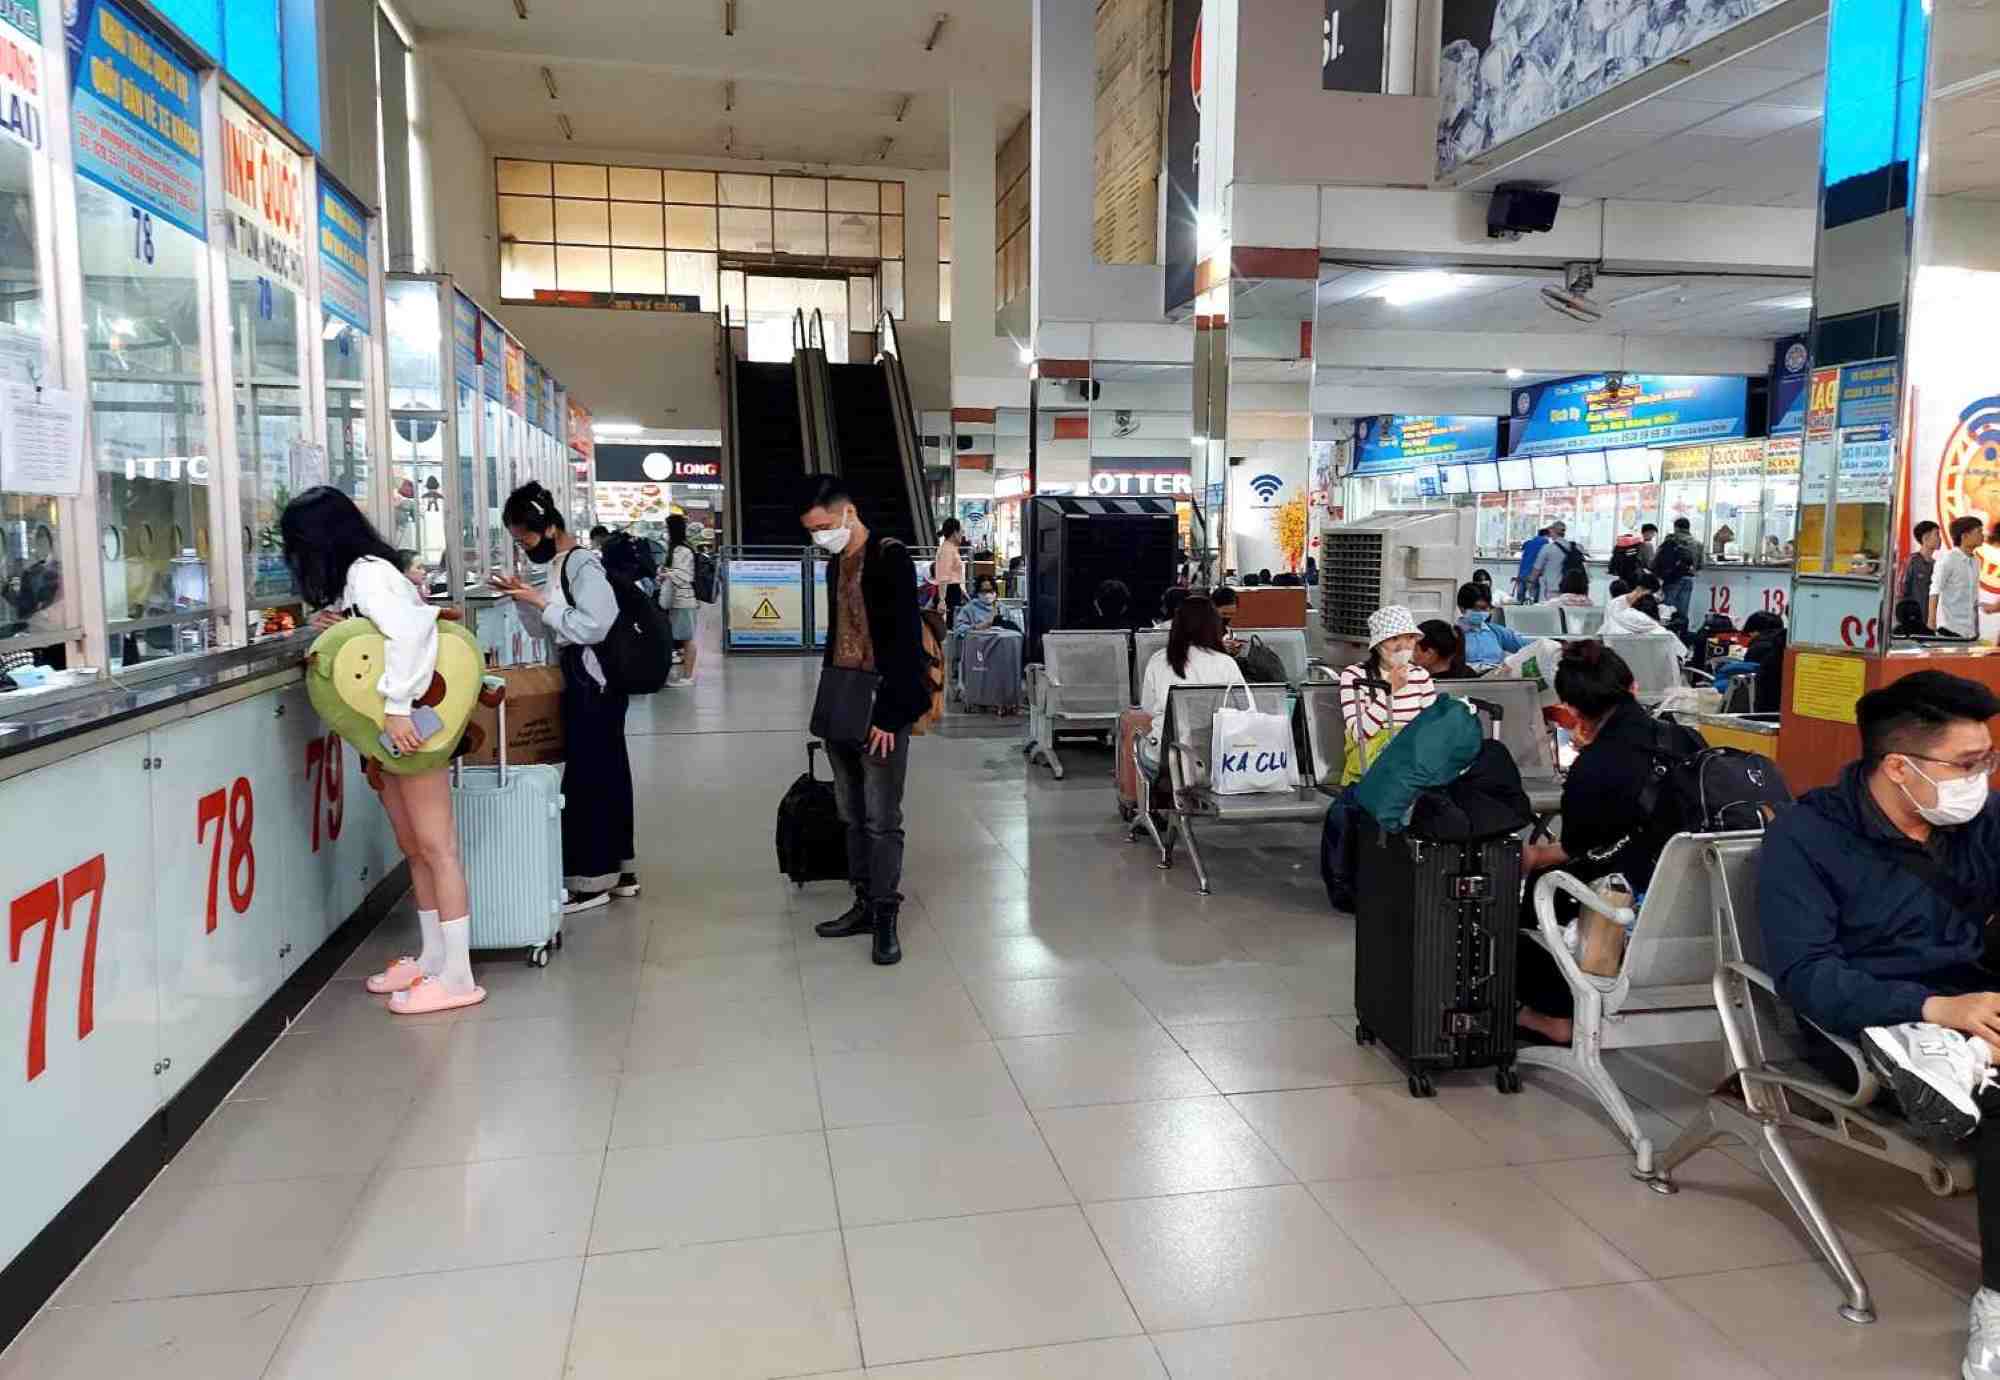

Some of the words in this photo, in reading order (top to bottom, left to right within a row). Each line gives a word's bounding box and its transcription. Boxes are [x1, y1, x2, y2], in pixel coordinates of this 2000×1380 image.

[1710, 586, 1730, 613] 12
[1763, 589, 1785, 616] 13
[305, 730, 344, 853] 79
[197, 776, 255, 935] 78
[9, 853, 106, 1081] 77
